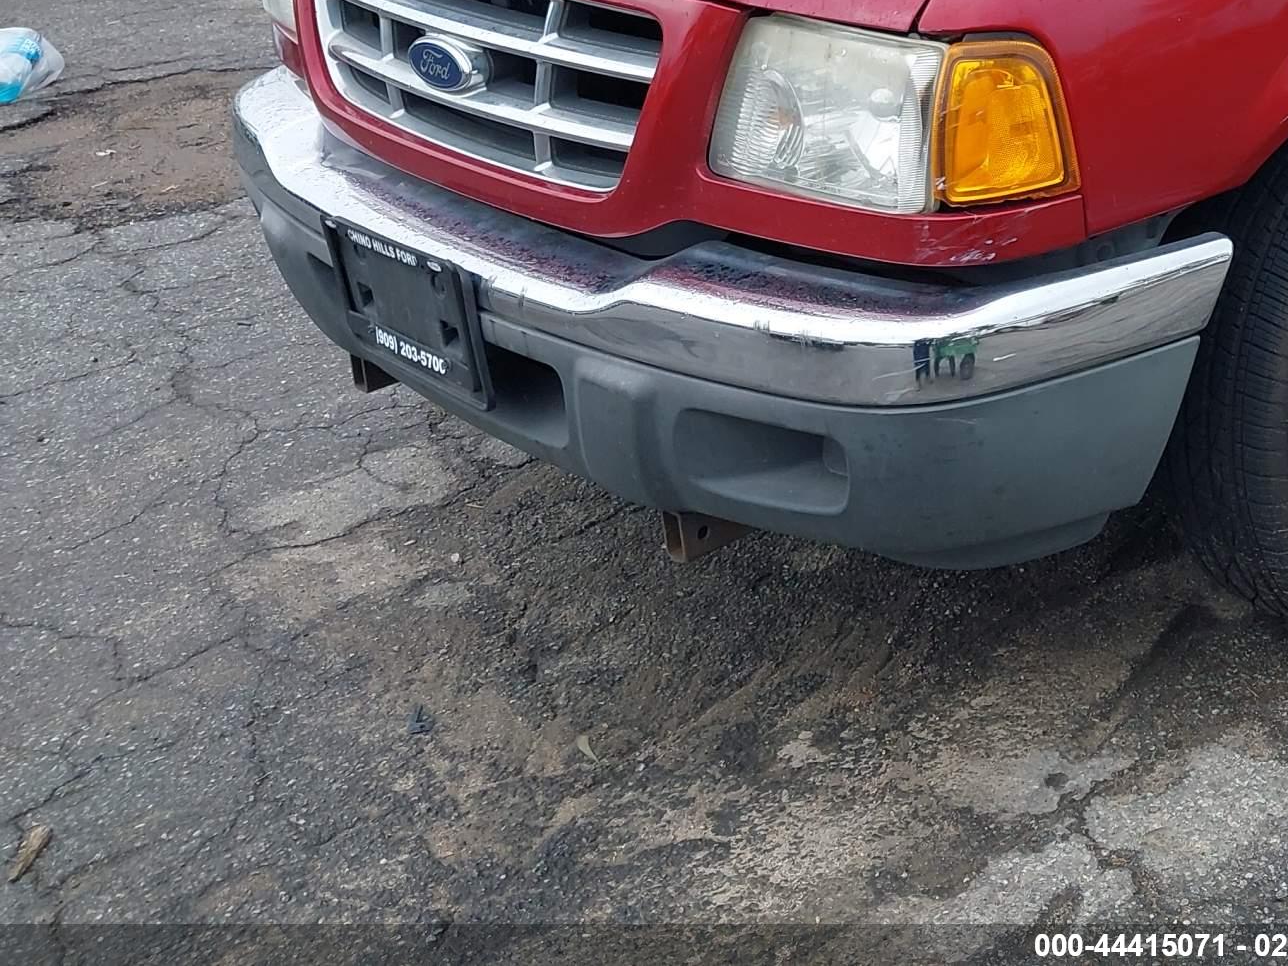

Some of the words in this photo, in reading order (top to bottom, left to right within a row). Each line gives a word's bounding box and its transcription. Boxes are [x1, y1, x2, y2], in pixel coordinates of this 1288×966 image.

[420, 48, 451, 81] Ford
[347, 229, 372, 249] CHINO
[372, 238, 396, 259] HILLS
[395, 247, 418, 267] FORD
[375, 326, 398, 354] (909)
[400, 340, 449, 375] 203-5700
